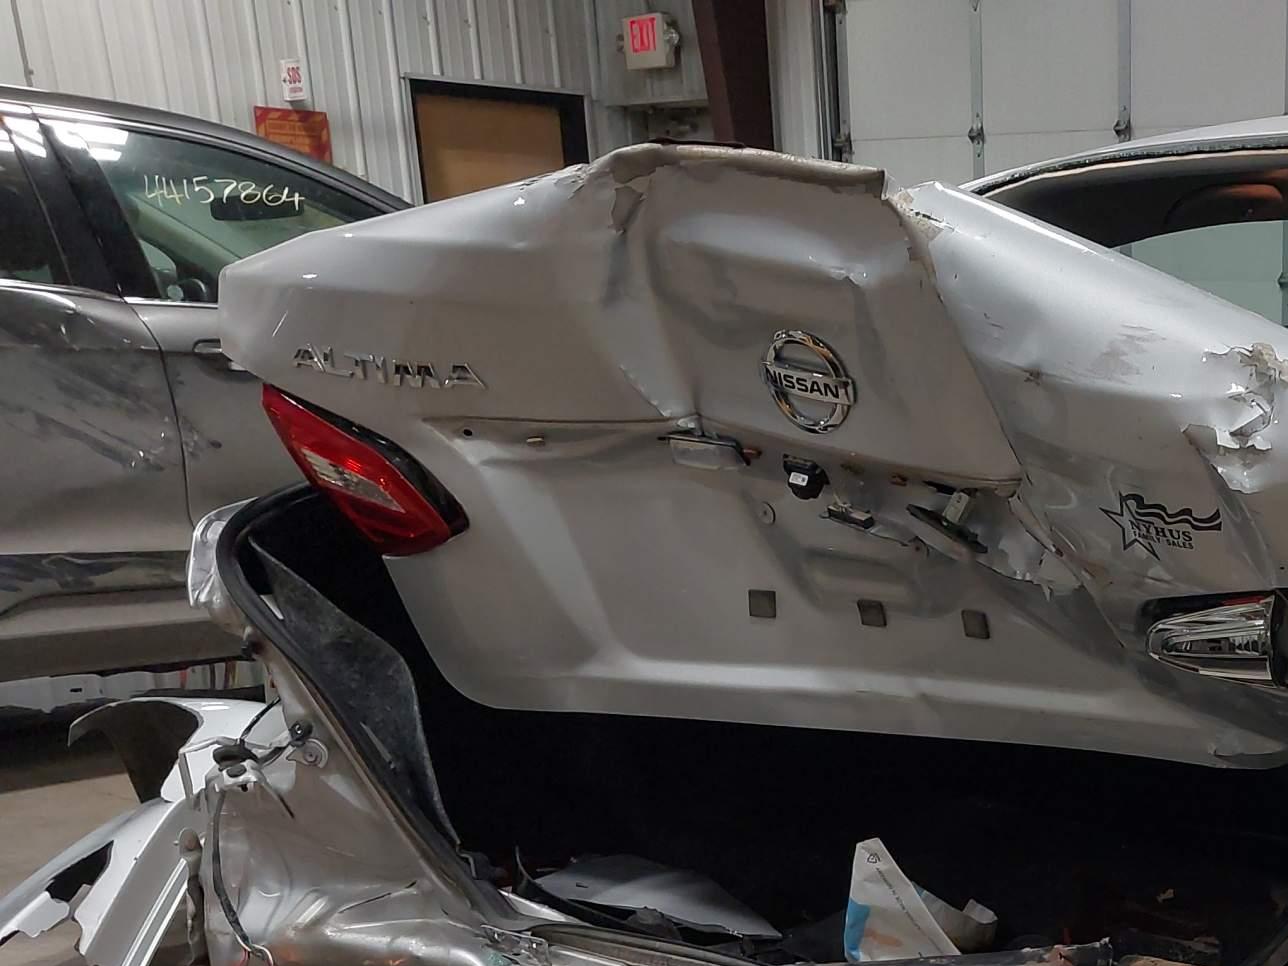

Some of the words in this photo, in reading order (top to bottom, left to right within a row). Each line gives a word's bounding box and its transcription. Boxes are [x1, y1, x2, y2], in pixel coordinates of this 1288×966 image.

[629, 17, 657, 53] EXIT
[143, 174, 305, 211] 44157864
[293, 343, 487, 390] ALTIMA
[765, 366, 840, 400] NISSAN
[1129, 520, 1193, 542] NYHUS
[1166, 539, 1194, 550] SALES
